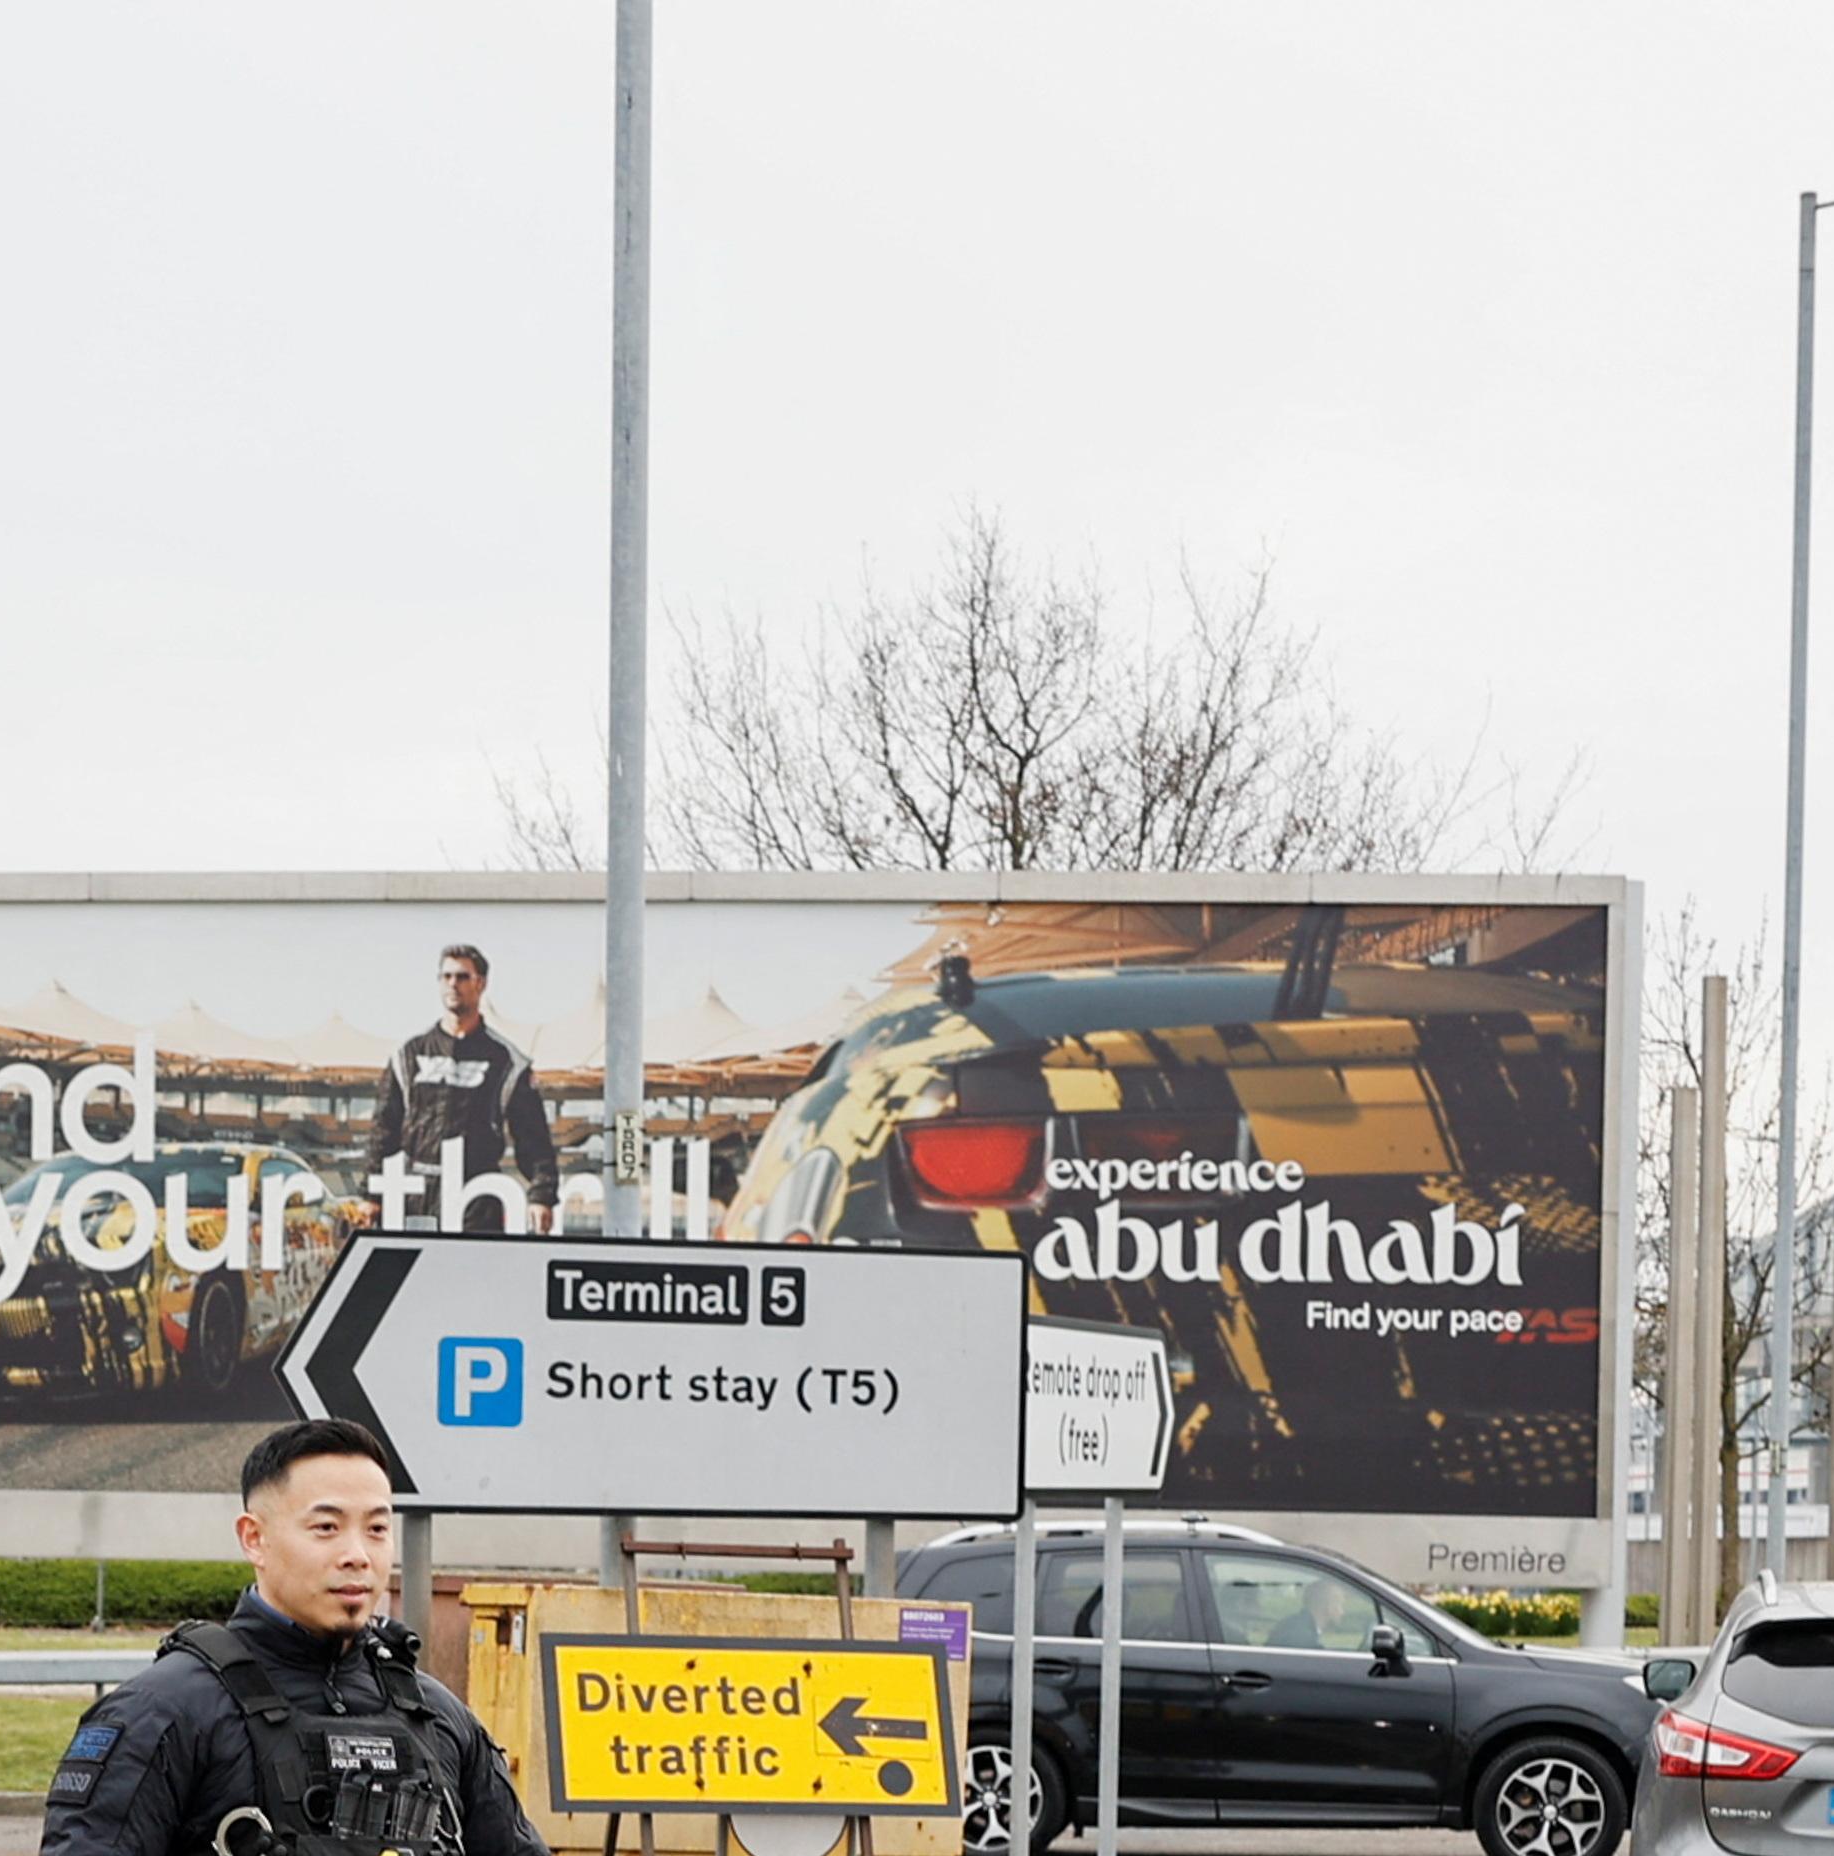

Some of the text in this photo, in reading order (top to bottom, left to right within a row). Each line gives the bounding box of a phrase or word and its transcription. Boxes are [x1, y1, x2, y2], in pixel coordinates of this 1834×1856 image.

[368, 1136, 711, 1238] thrll
[1033, 1199, 1526, 1286] abu dhabi
[554, 1269, 798, 1318] Terminal 5
[1306, 1301, 1523, 1338] Find your pace
[453, 1345, 900, 1418] P Short stay (T5)
[1028, 1355, 1147, 1408] emote drop off
[1059, 1411, 1109, 1467] (free)
[1428, 1543, 1566, 1574] Première
[576, 1672, 801, 1716] Diverted
[609, 1735, 780, 1776] traffic
